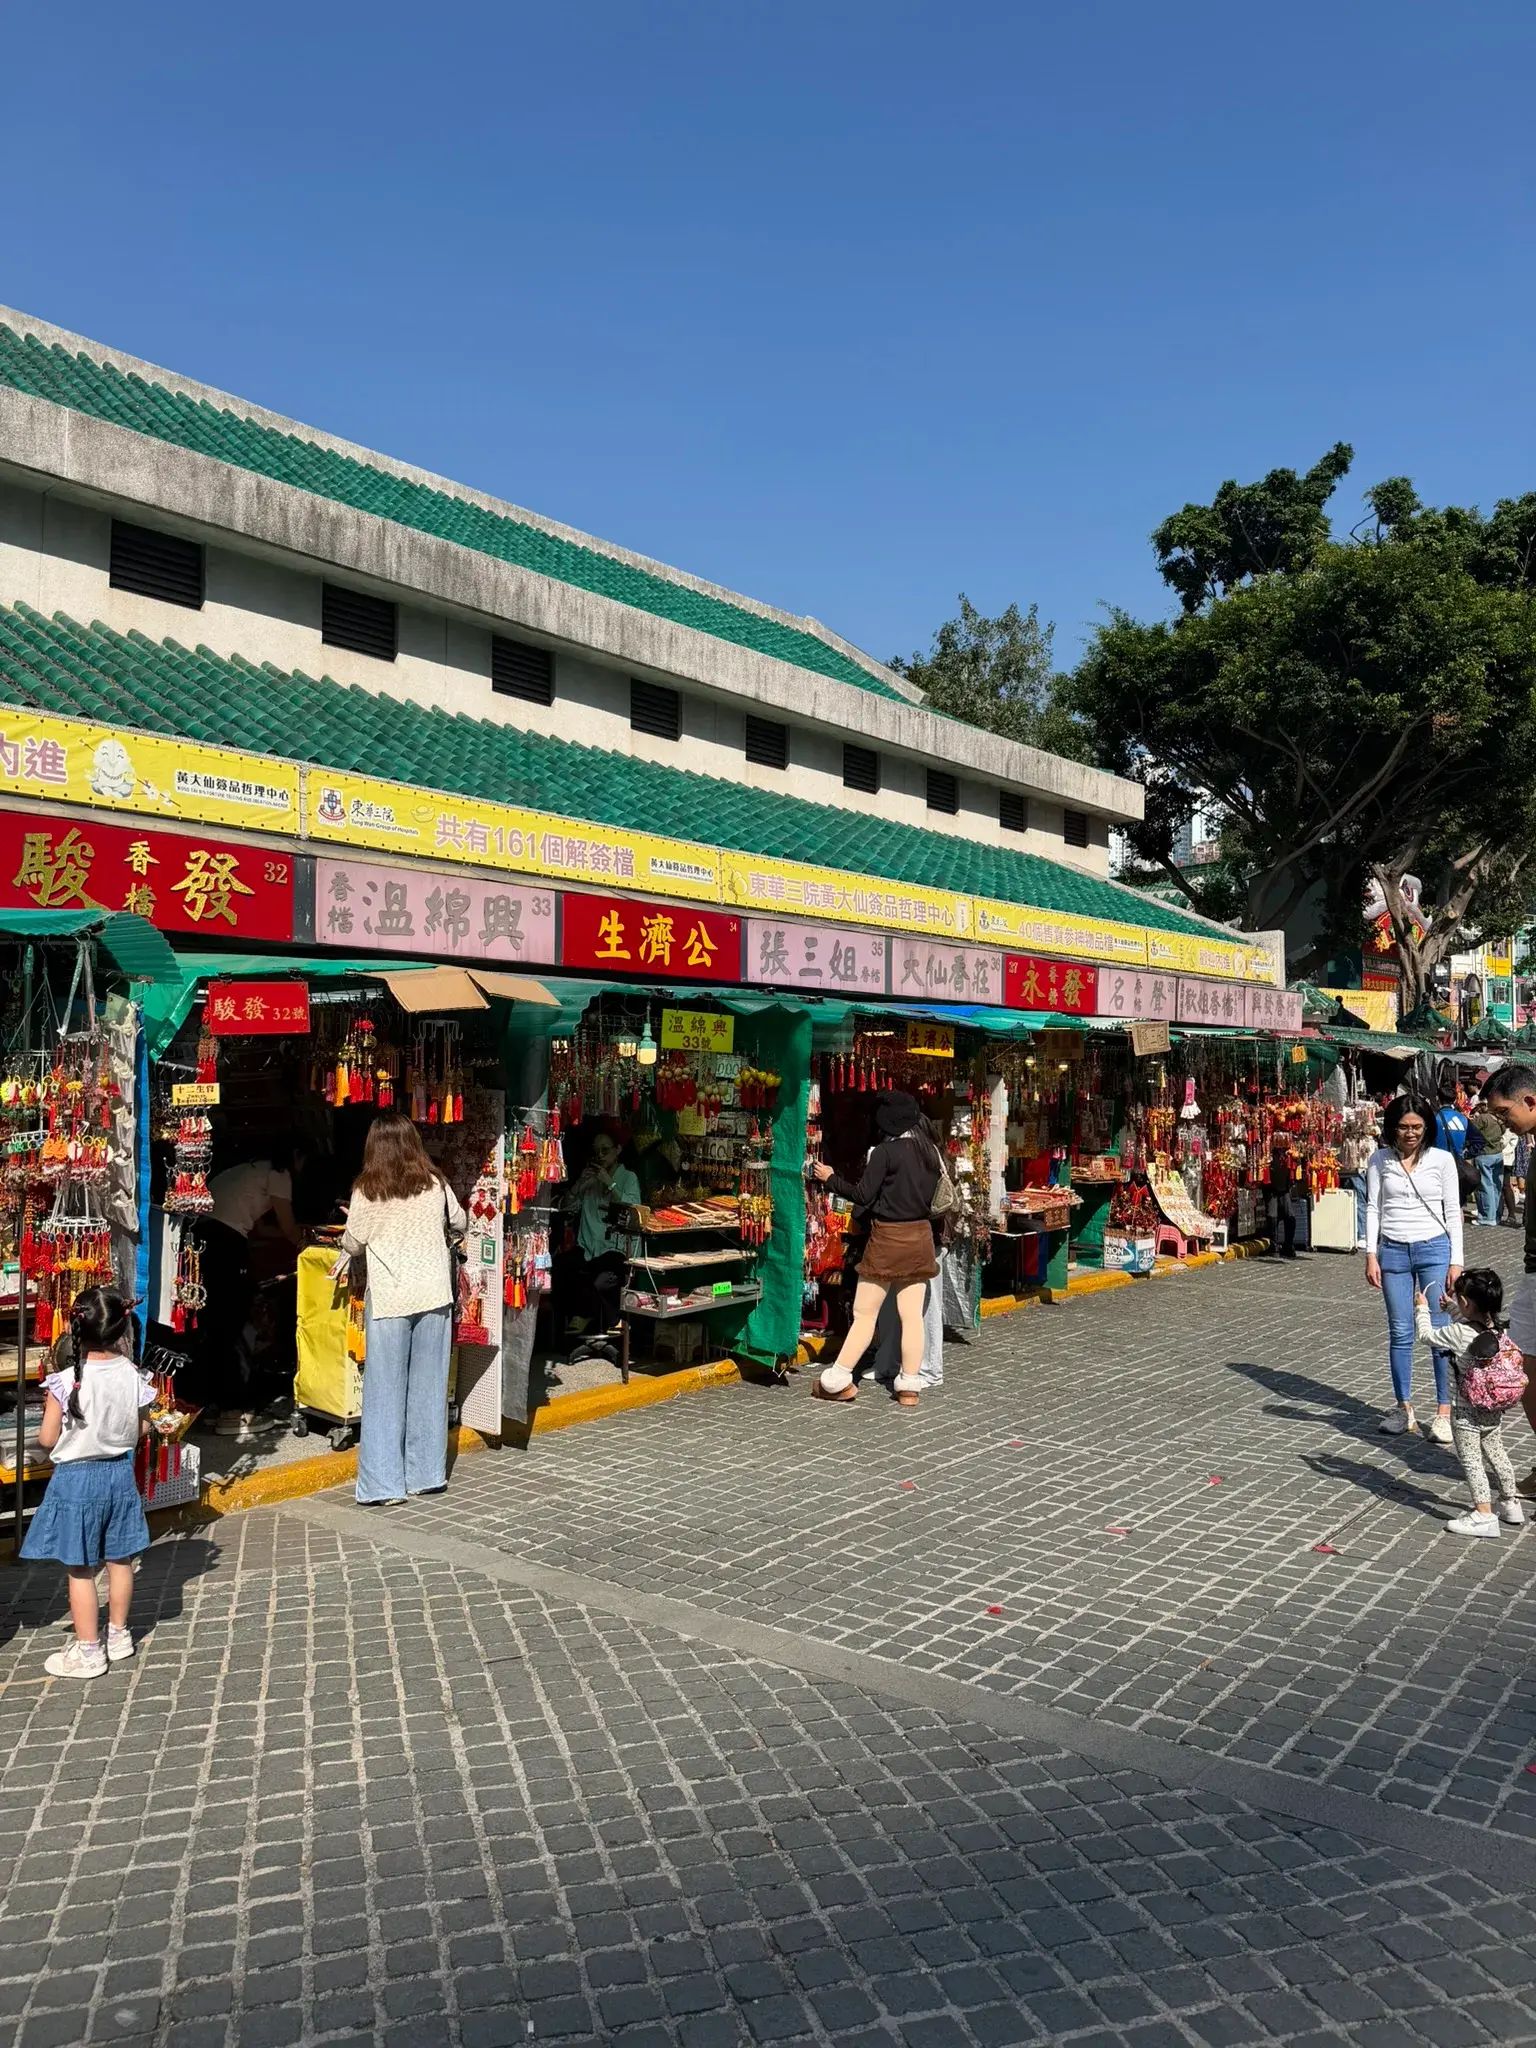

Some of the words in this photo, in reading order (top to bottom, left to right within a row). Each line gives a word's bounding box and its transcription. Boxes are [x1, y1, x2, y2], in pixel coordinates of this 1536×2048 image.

[263, 862, 288, 885] 32
[531, 896, 552, 917] 33
[729, 921, 737, 933] 34
[760, 931, 859, 983] 張三姐
[871, 941, 883, 958] 35
[990, 956, 1000, 972] 36
[212, 996, 271, 1021] 駿發
[272, 1006, 308, 1021] 32號
[682, 1035, 712, 1050] 33號
